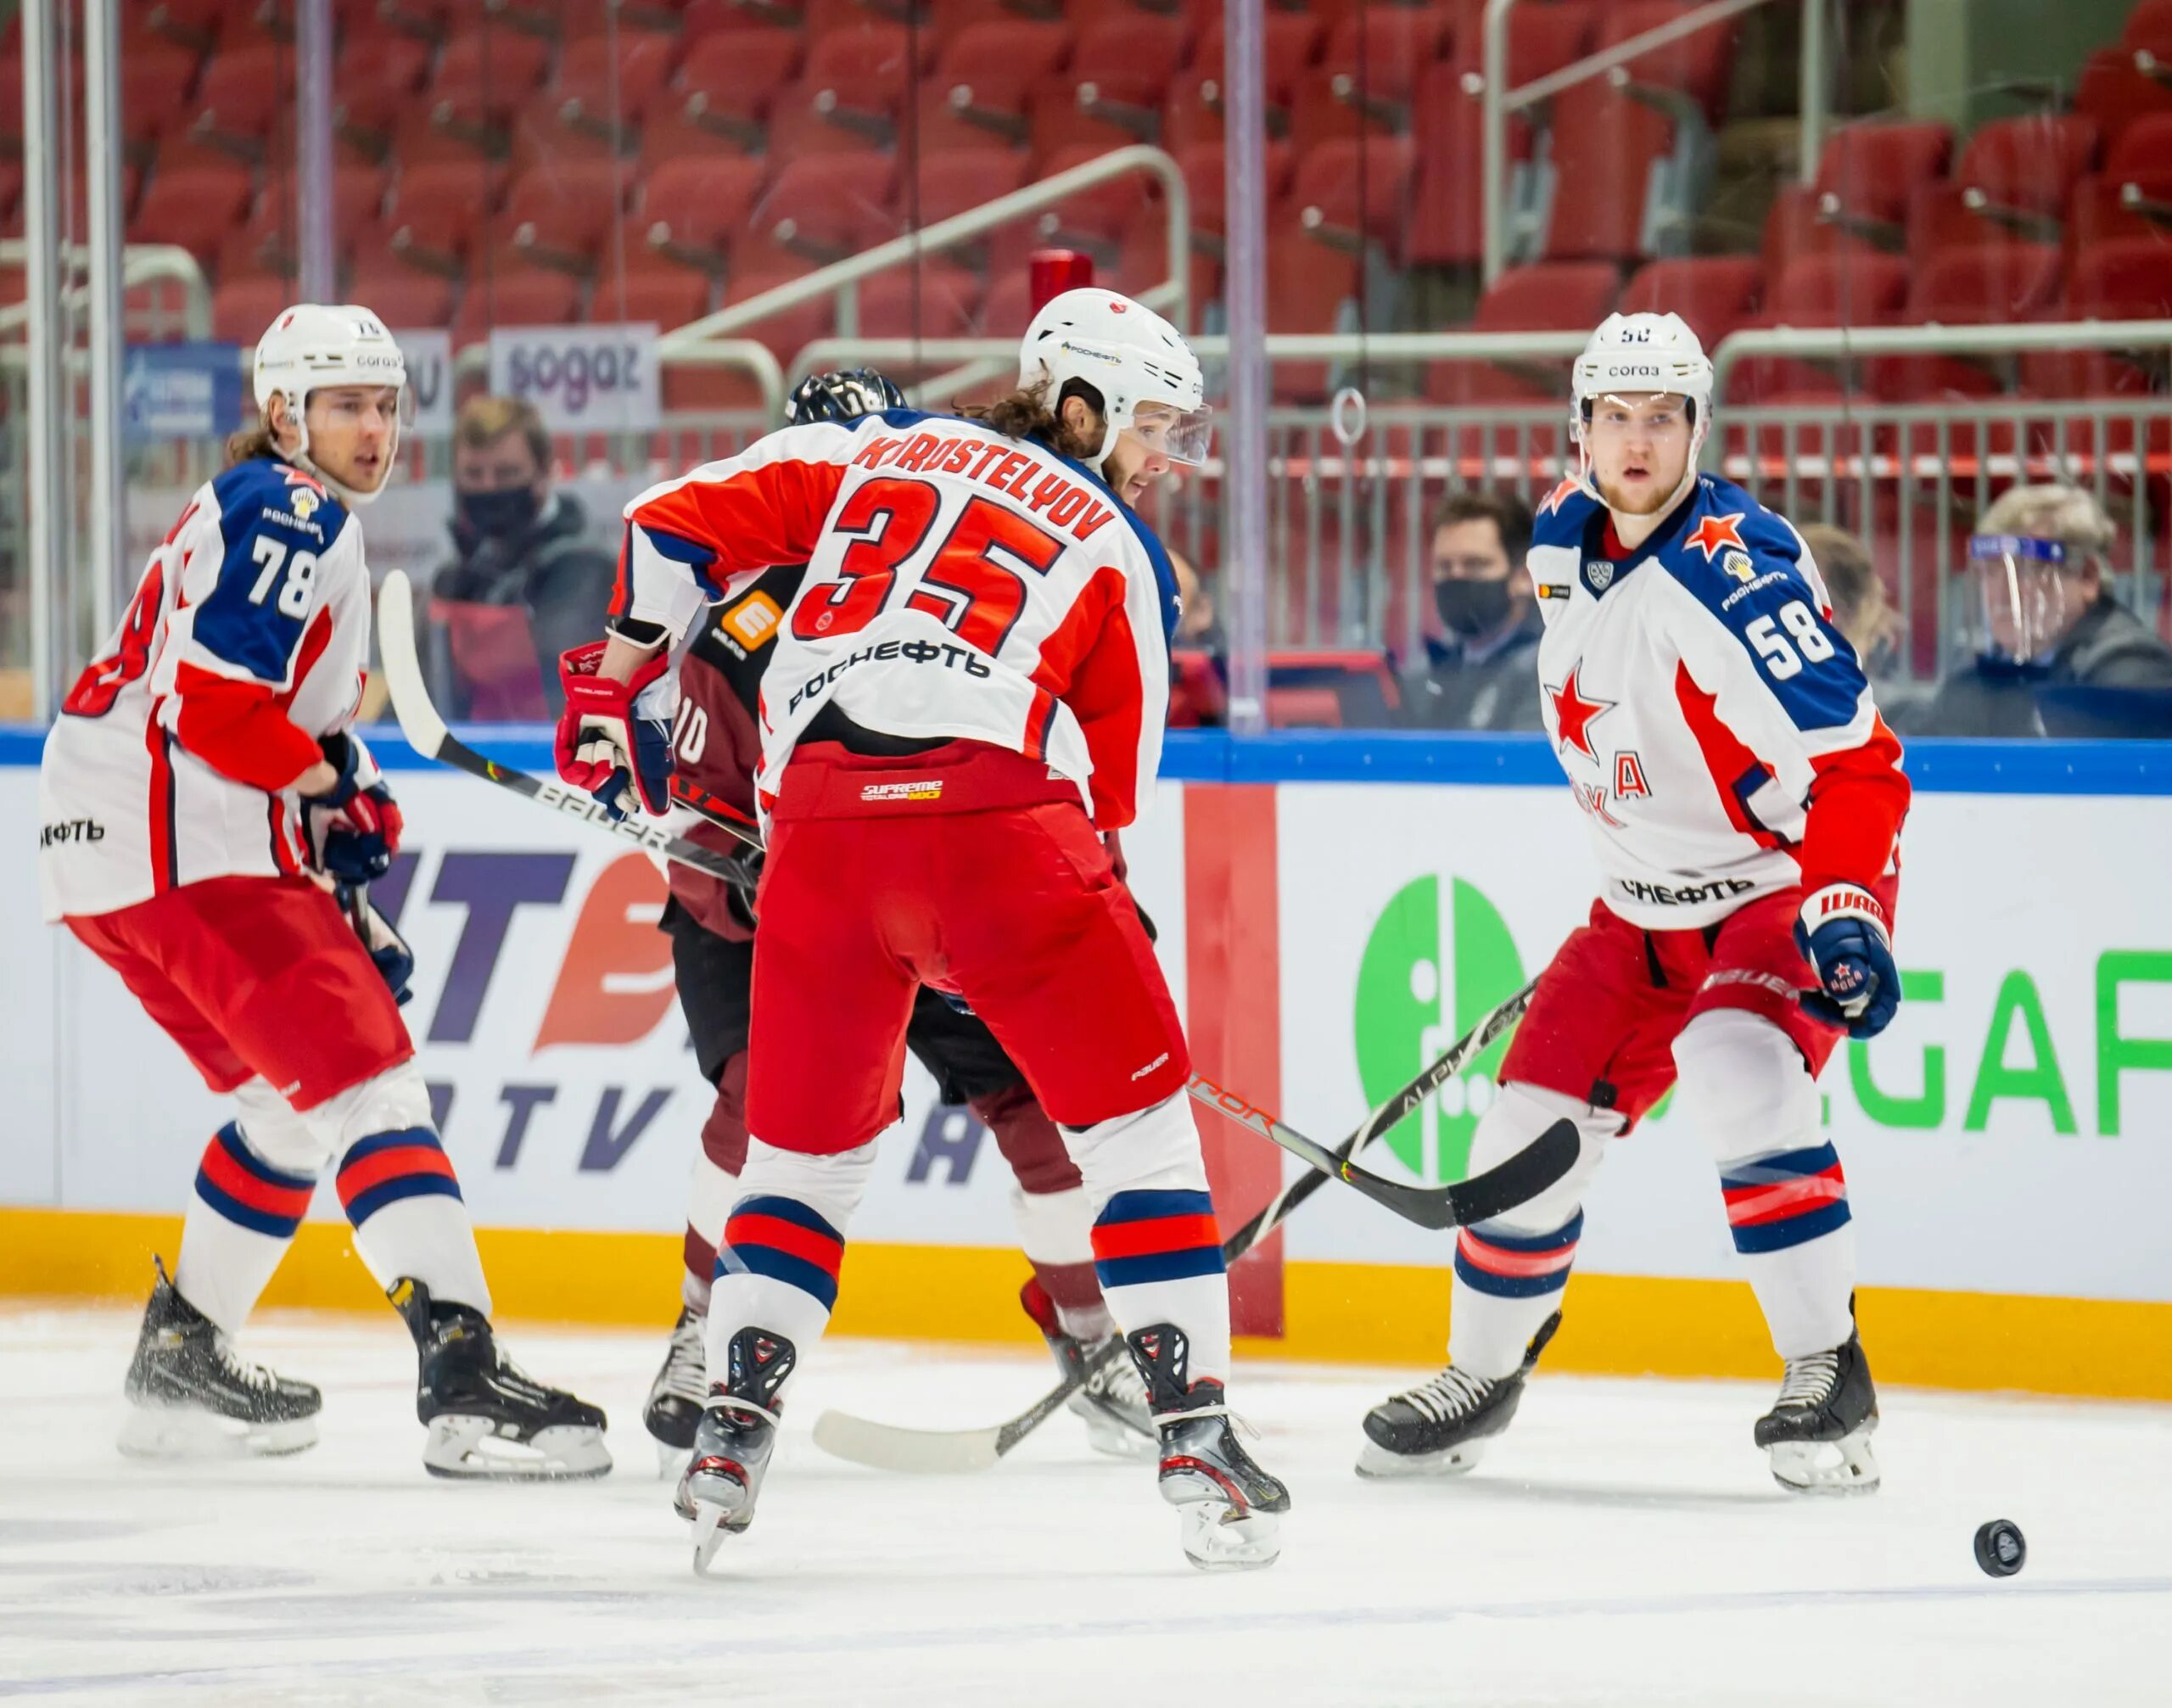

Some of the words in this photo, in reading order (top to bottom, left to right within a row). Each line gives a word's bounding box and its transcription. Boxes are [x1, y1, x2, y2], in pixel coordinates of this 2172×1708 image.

[510, 341, 641, 414] sogaz
[248, 534, 318, 621] 78
[790, 475, 1067, 659] 35
[1744, 599, 1836, 680] 58
[789, 640, 991, 716] РОСНЕФТЬ
[861, 780, 943, 795] SUPREME
[40, 817, 105, 851] ЕФТЬ
